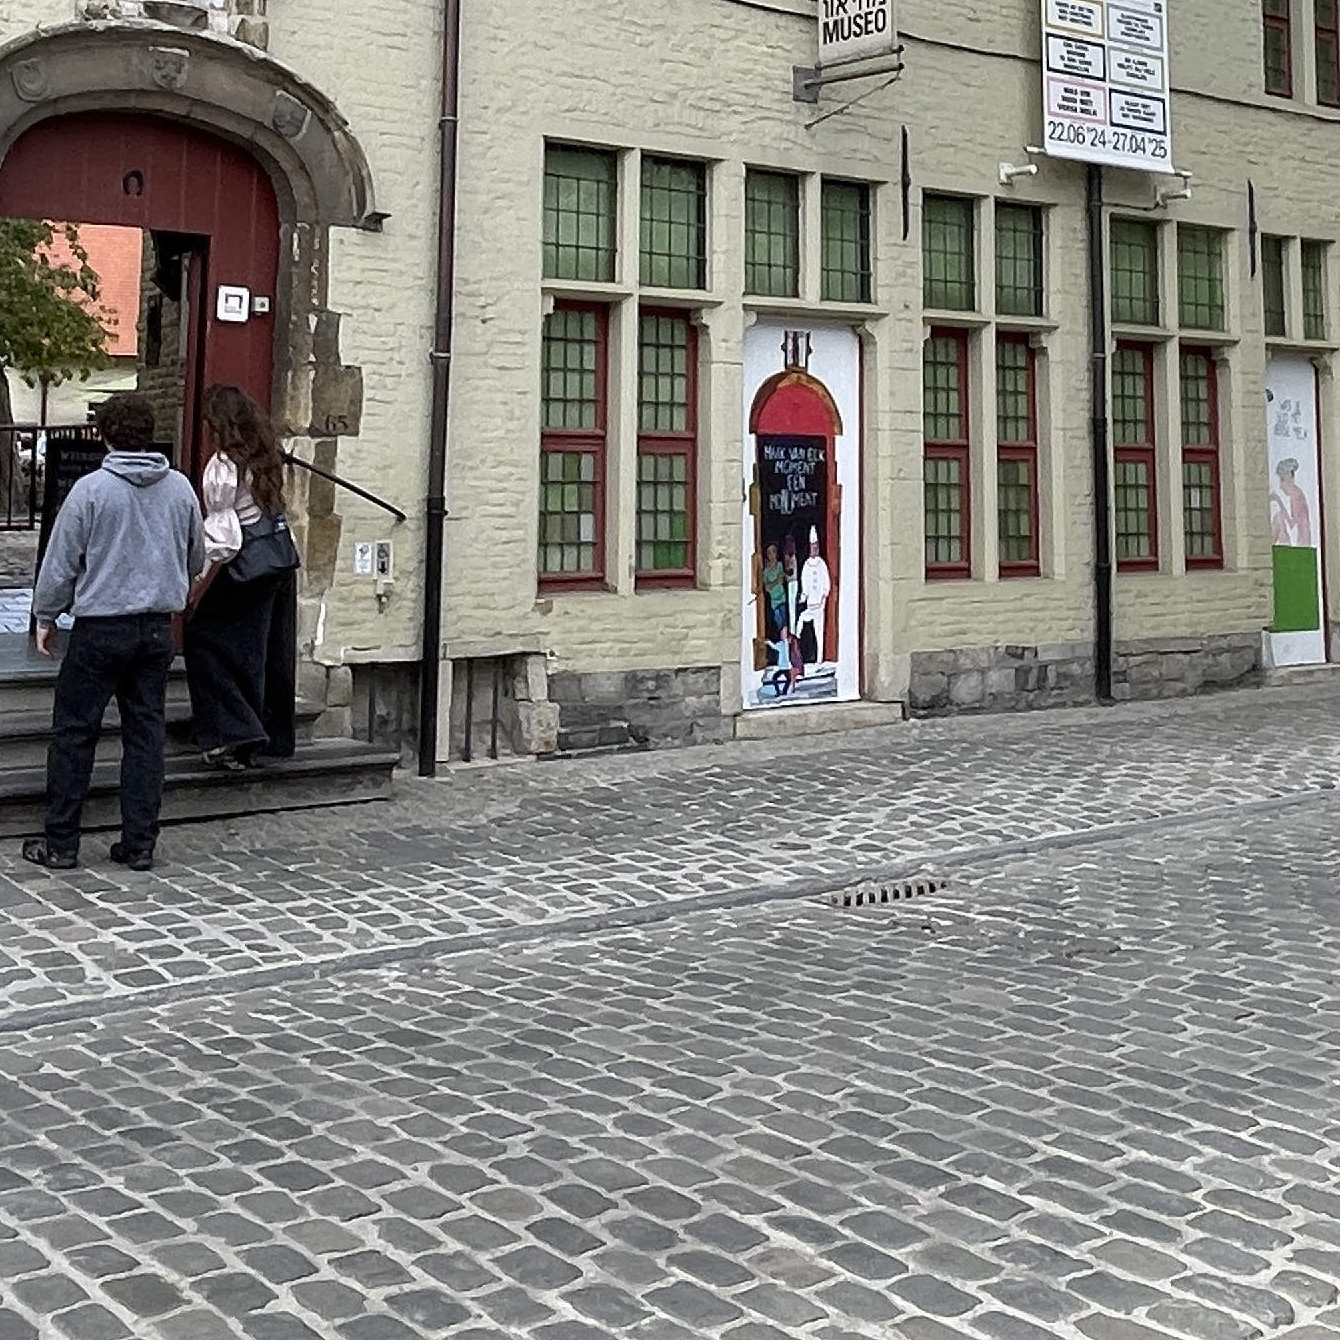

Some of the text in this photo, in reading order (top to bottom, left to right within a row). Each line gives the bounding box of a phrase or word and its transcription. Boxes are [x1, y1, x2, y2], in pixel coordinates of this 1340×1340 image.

[822, 8, 887, 45] MUSEO
[324, 413, 349, 431] 65
[774, 460, 816, 475] MOMENT
